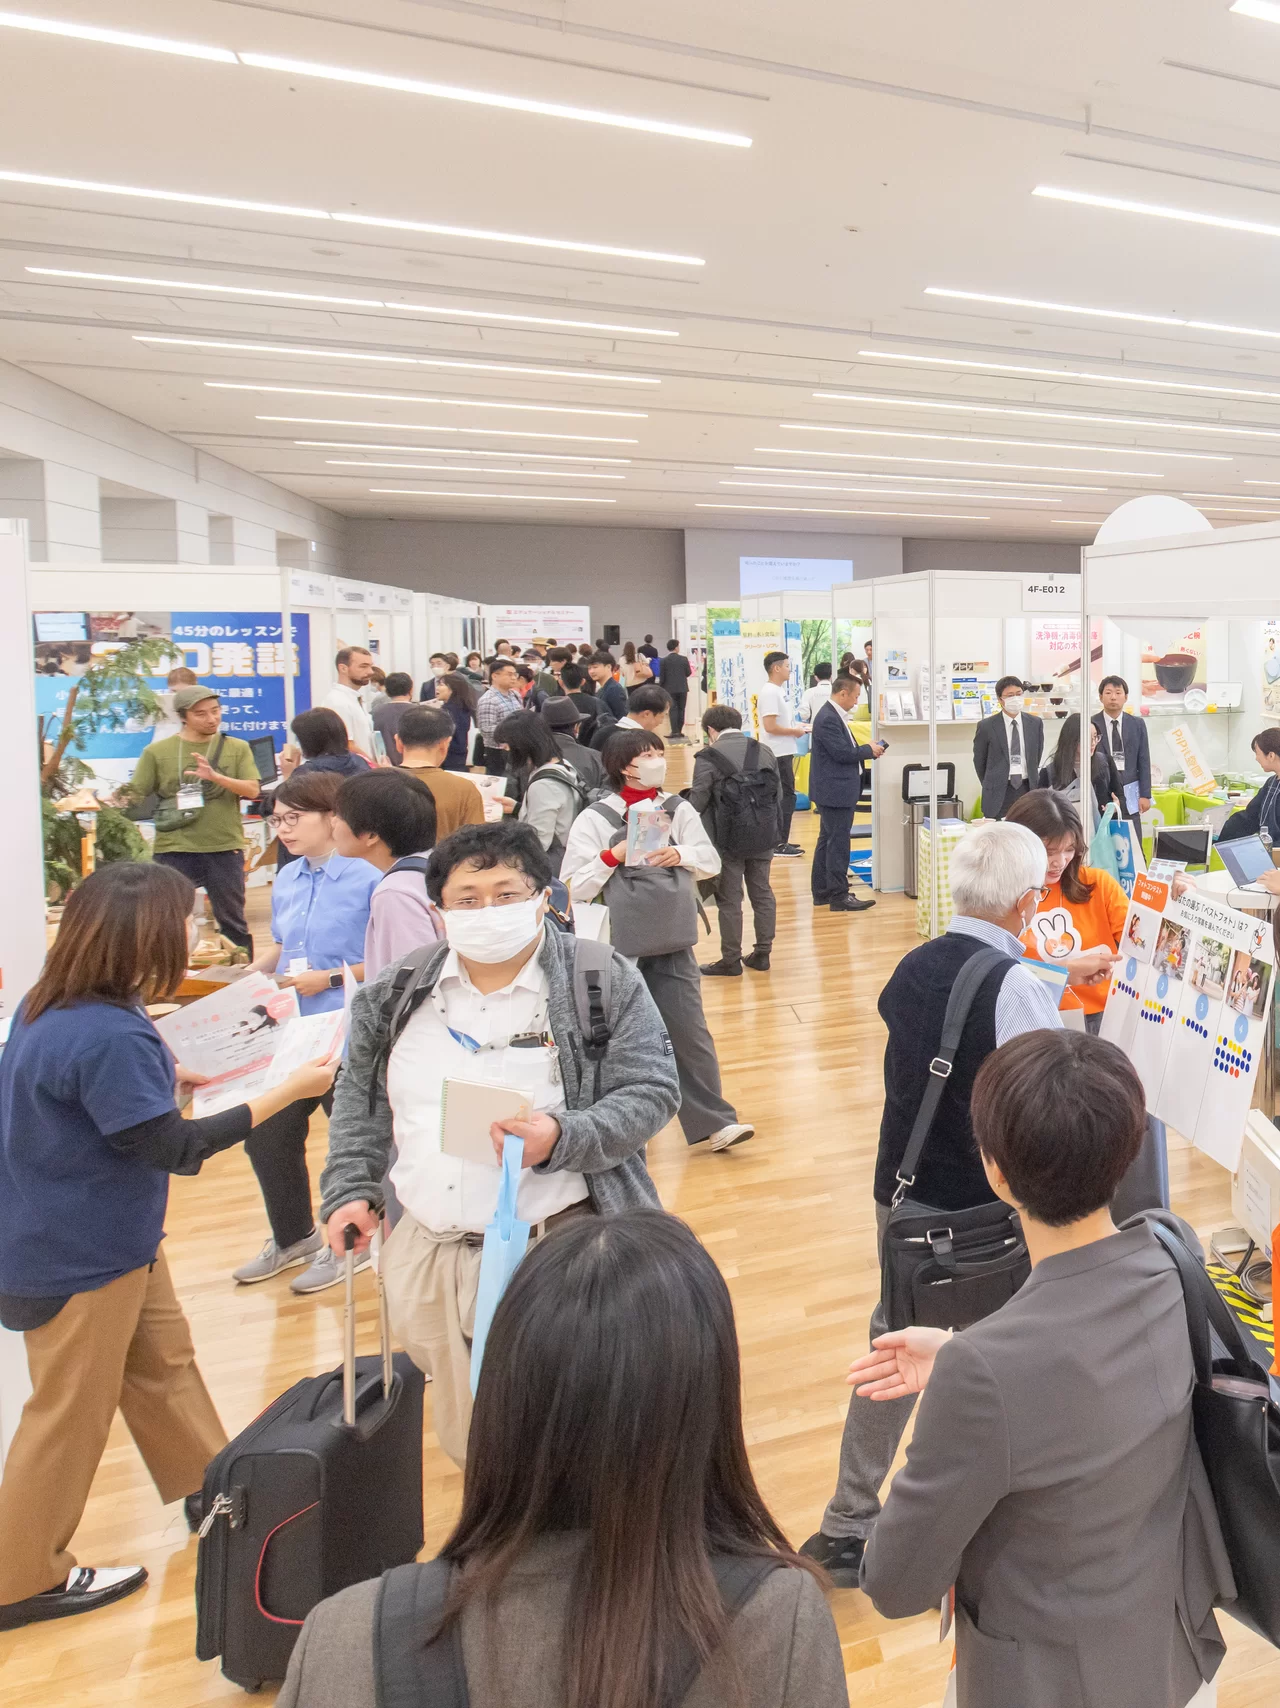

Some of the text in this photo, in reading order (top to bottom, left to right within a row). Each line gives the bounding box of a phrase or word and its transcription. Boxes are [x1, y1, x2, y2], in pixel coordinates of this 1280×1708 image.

[1028, 586, 1065, 594] 4F-E012
[1035, 631, 1098, 641] 洗浄機・消毒保庫
[1173, 894, 1249, 934] なたの選ぶ「ベストフォト」は?
